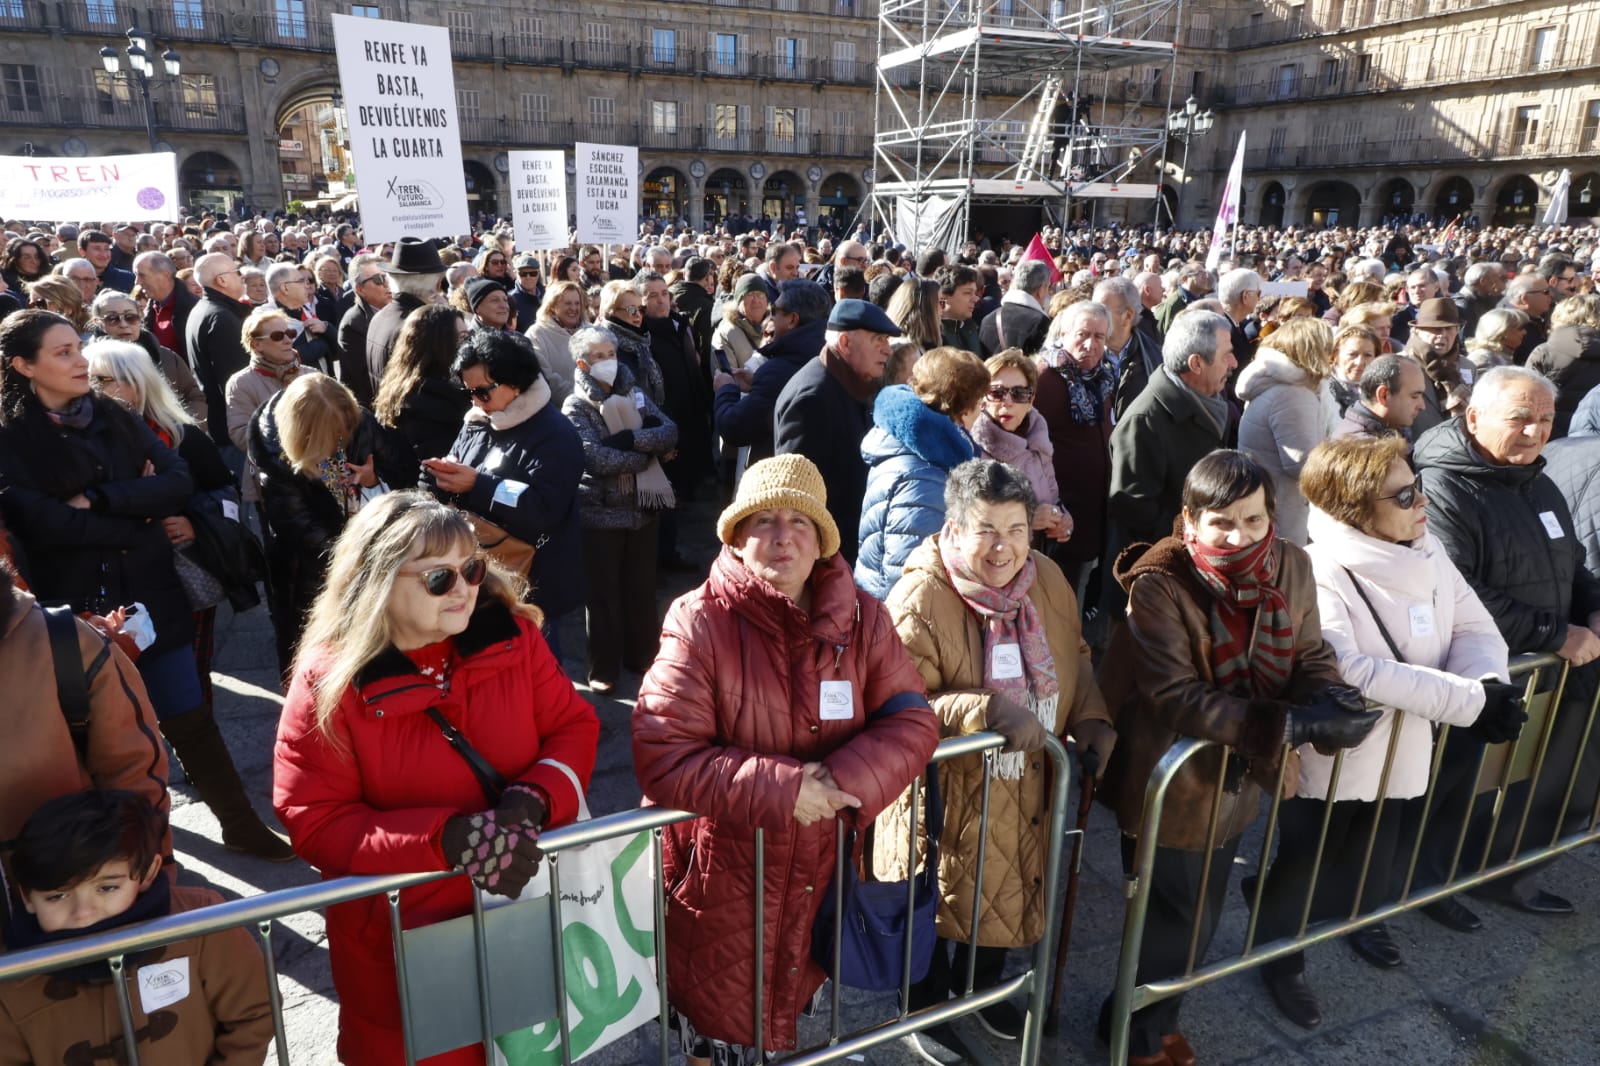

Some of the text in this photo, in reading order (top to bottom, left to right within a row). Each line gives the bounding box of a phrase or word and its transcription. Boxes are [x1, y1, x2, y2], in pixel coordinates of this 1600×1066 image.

[364, 40, 428, 66] RENFE YA
[377, 73, 424, 100] BASTA,
[359, 103, 447, 128] DEVUÉLVENOS
[372, 137, 444, 158] LA CUARTA
[591, 149, 624, 163] SÁNCHEZ
[522, 160, 553, 170] RENFE YA
[589, 164, 625, 176] ESCUCHA,
[23, 163, 120, 183] TREN
[586, 175, 629, 187] SALAMANCA
[398, 185, 420, 194] TREN
[516, 187, 561, 199] DEVUÉLVENOS
[587, 187, 628, 199] ESTÁ EN LA
[397, 193, 424, 202] FUTURO
[399, 200, 432, 208] SALAMANCA
[522, 202, 558, 213] LA CUARTA
[596, 199, 620, 210] LUCHA
